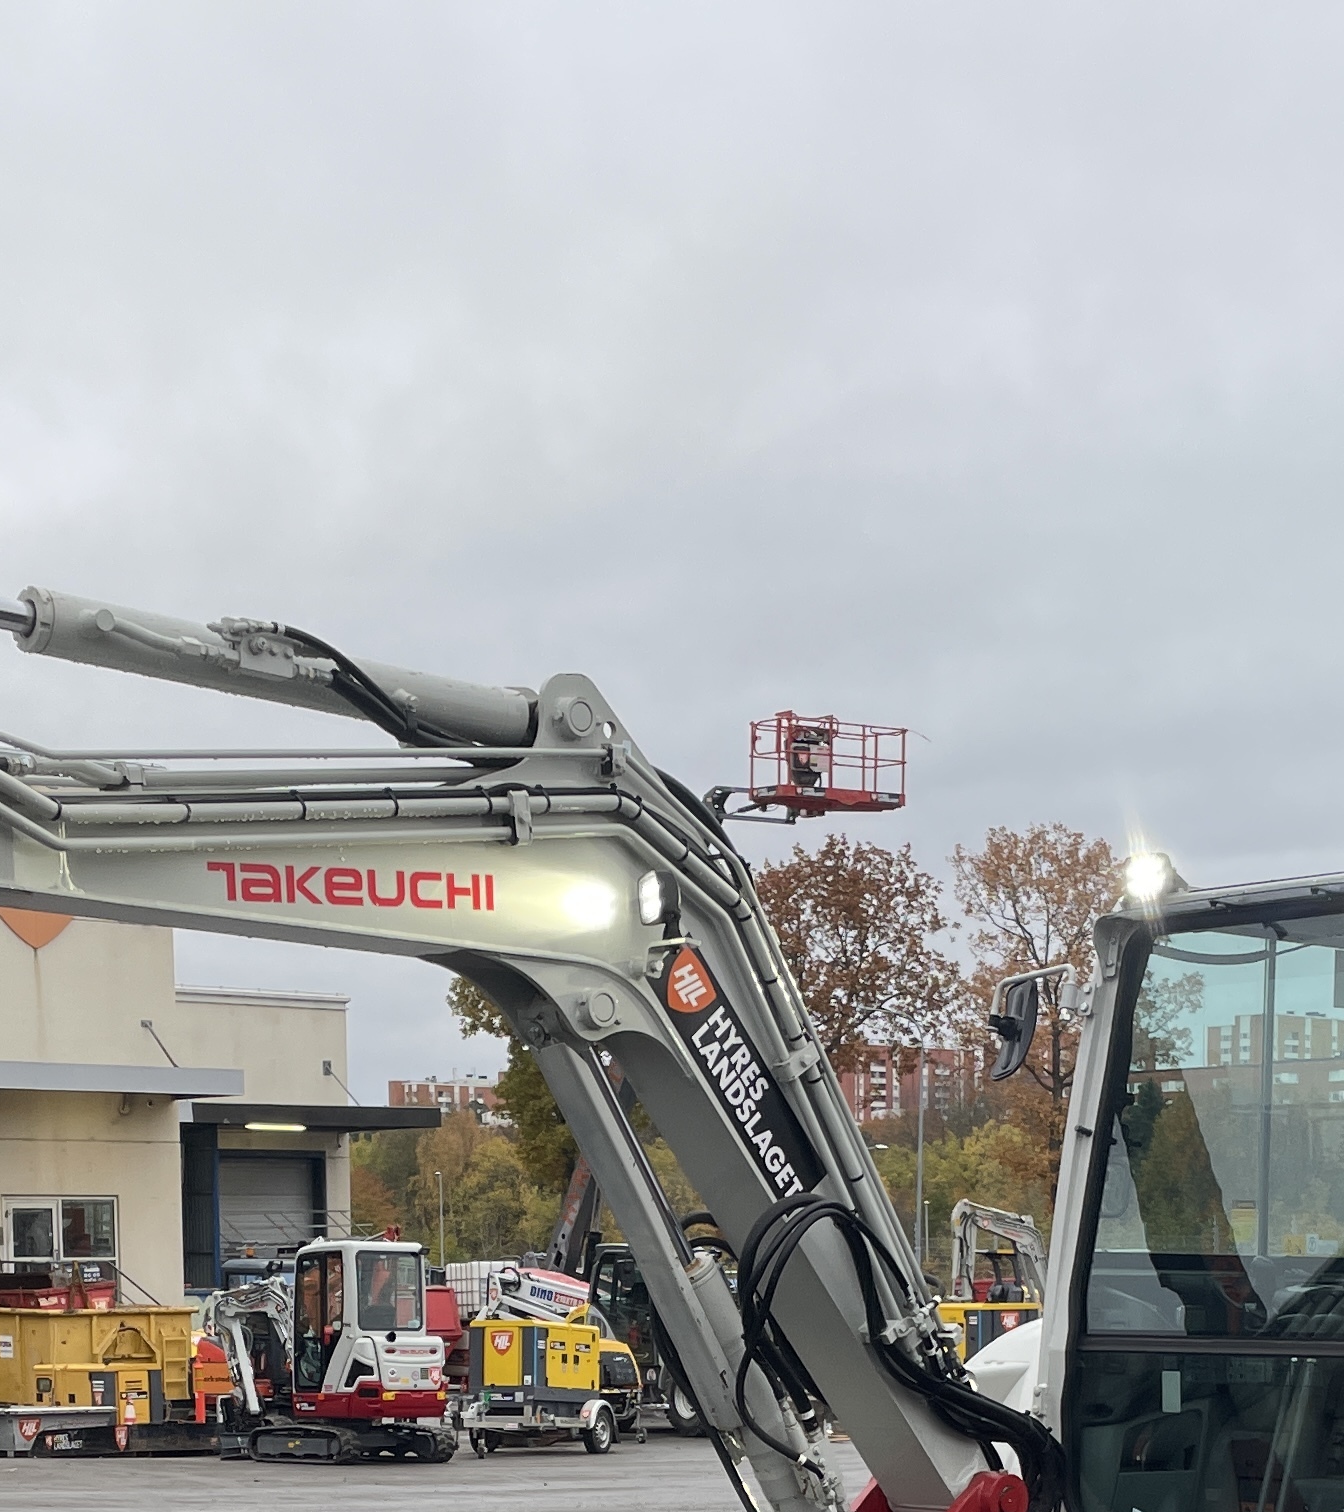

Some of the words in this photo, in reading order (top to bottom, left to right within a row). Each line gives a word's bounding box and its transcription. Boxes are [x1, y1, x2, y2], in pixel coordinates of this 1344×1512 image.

[207, 861, 495, 911] TAKEUCHI
[707, 1005, 770, 1101] HYRES
[529, 1285, 554, 1301] DINO
